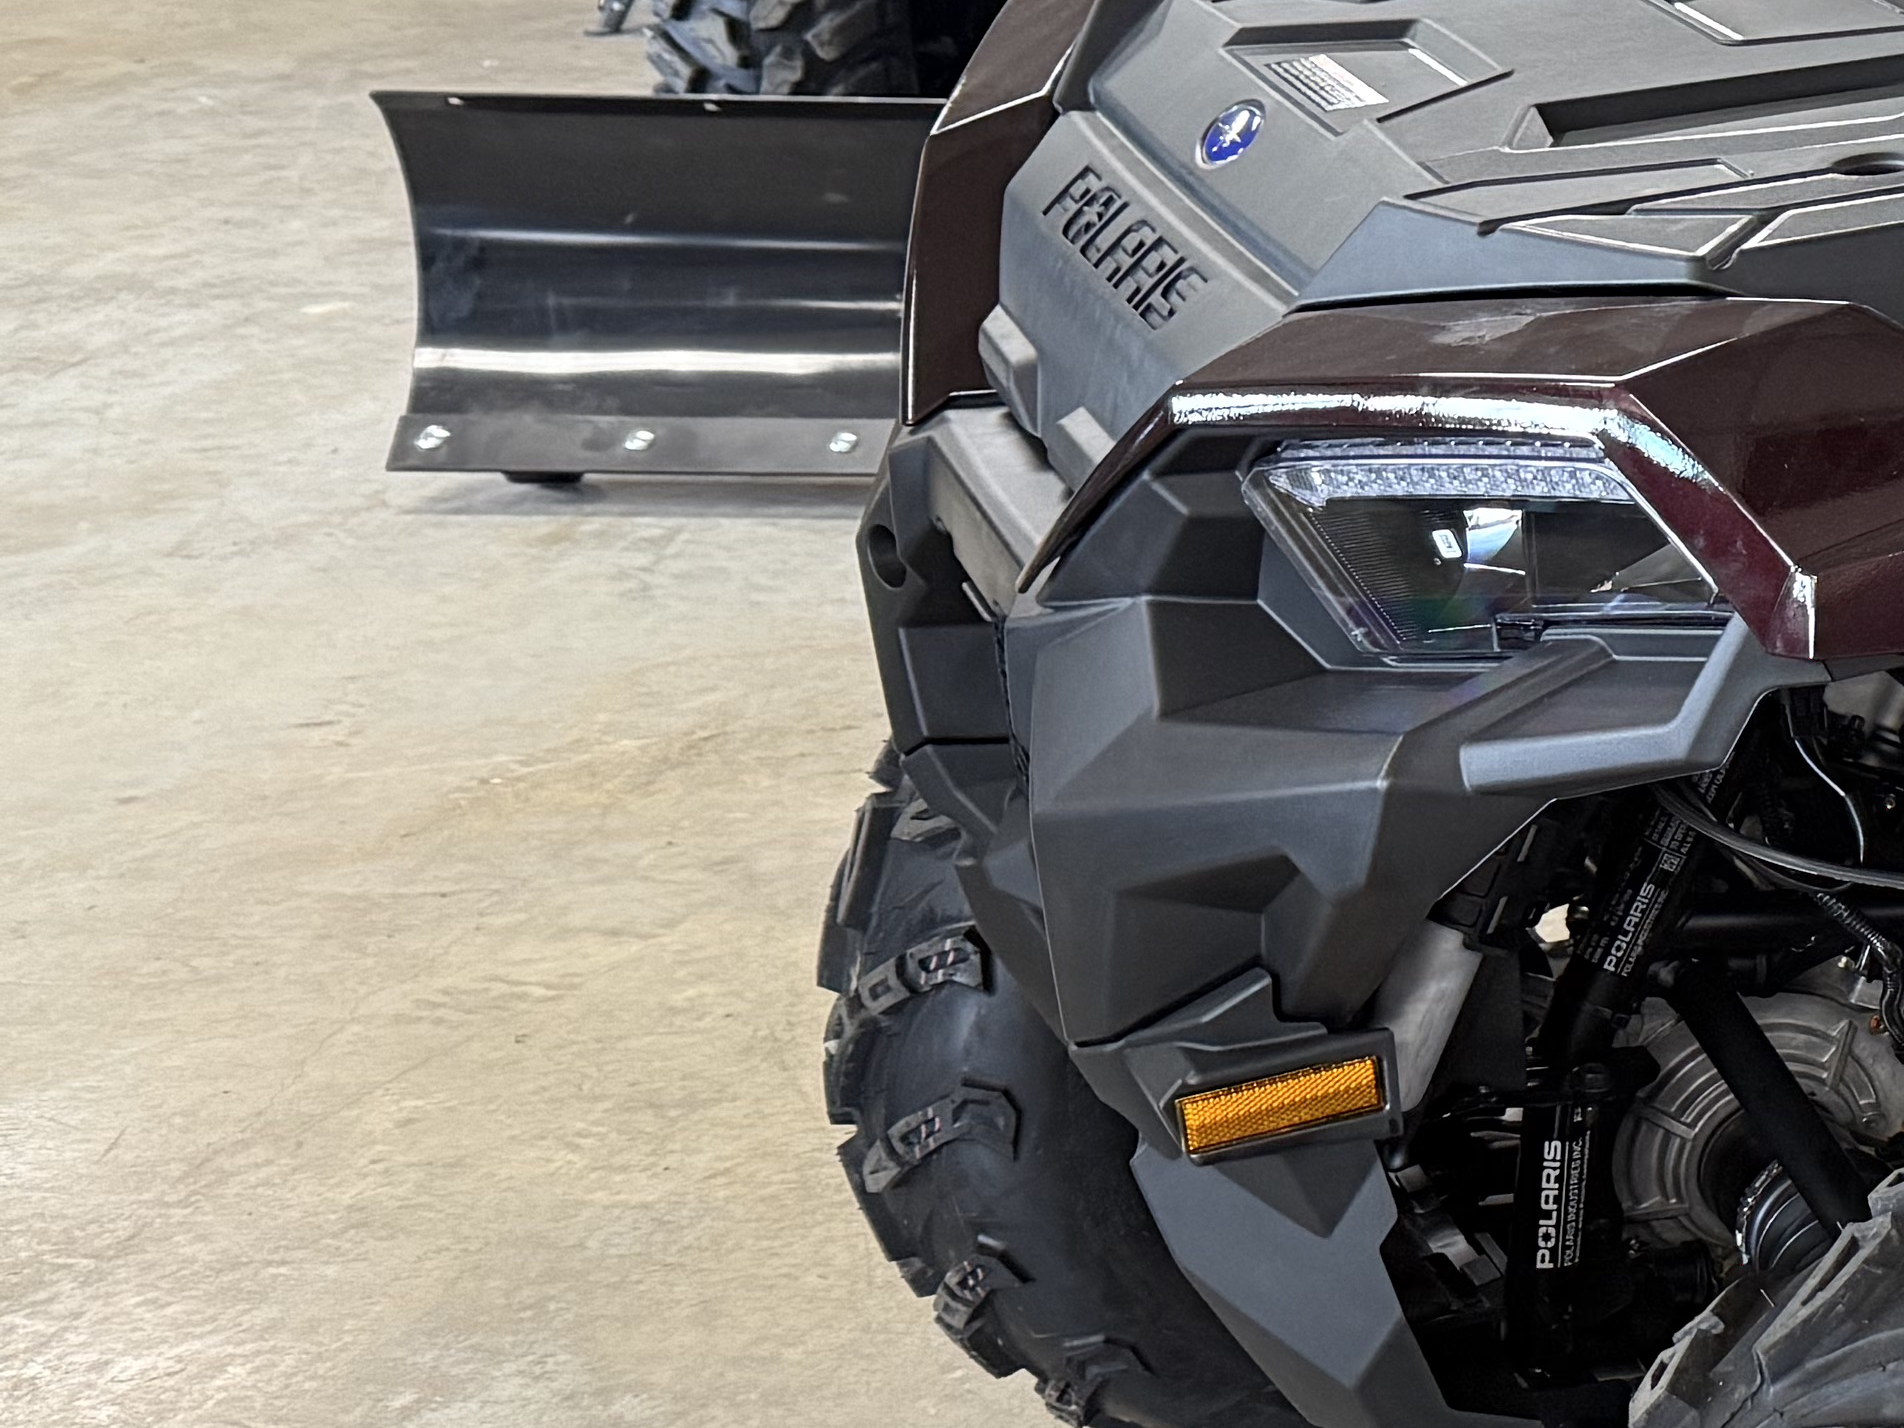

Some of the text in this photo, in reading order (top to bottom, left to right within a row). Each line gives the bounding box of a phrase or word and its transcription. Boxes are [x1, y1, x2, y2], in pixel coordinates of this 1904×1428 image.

[1041, 164, 1209, 332] POLARIS
[1602, 882, 1656, 973] POLARIS
[1535, 1139, 1562, 1270] POLARIS
